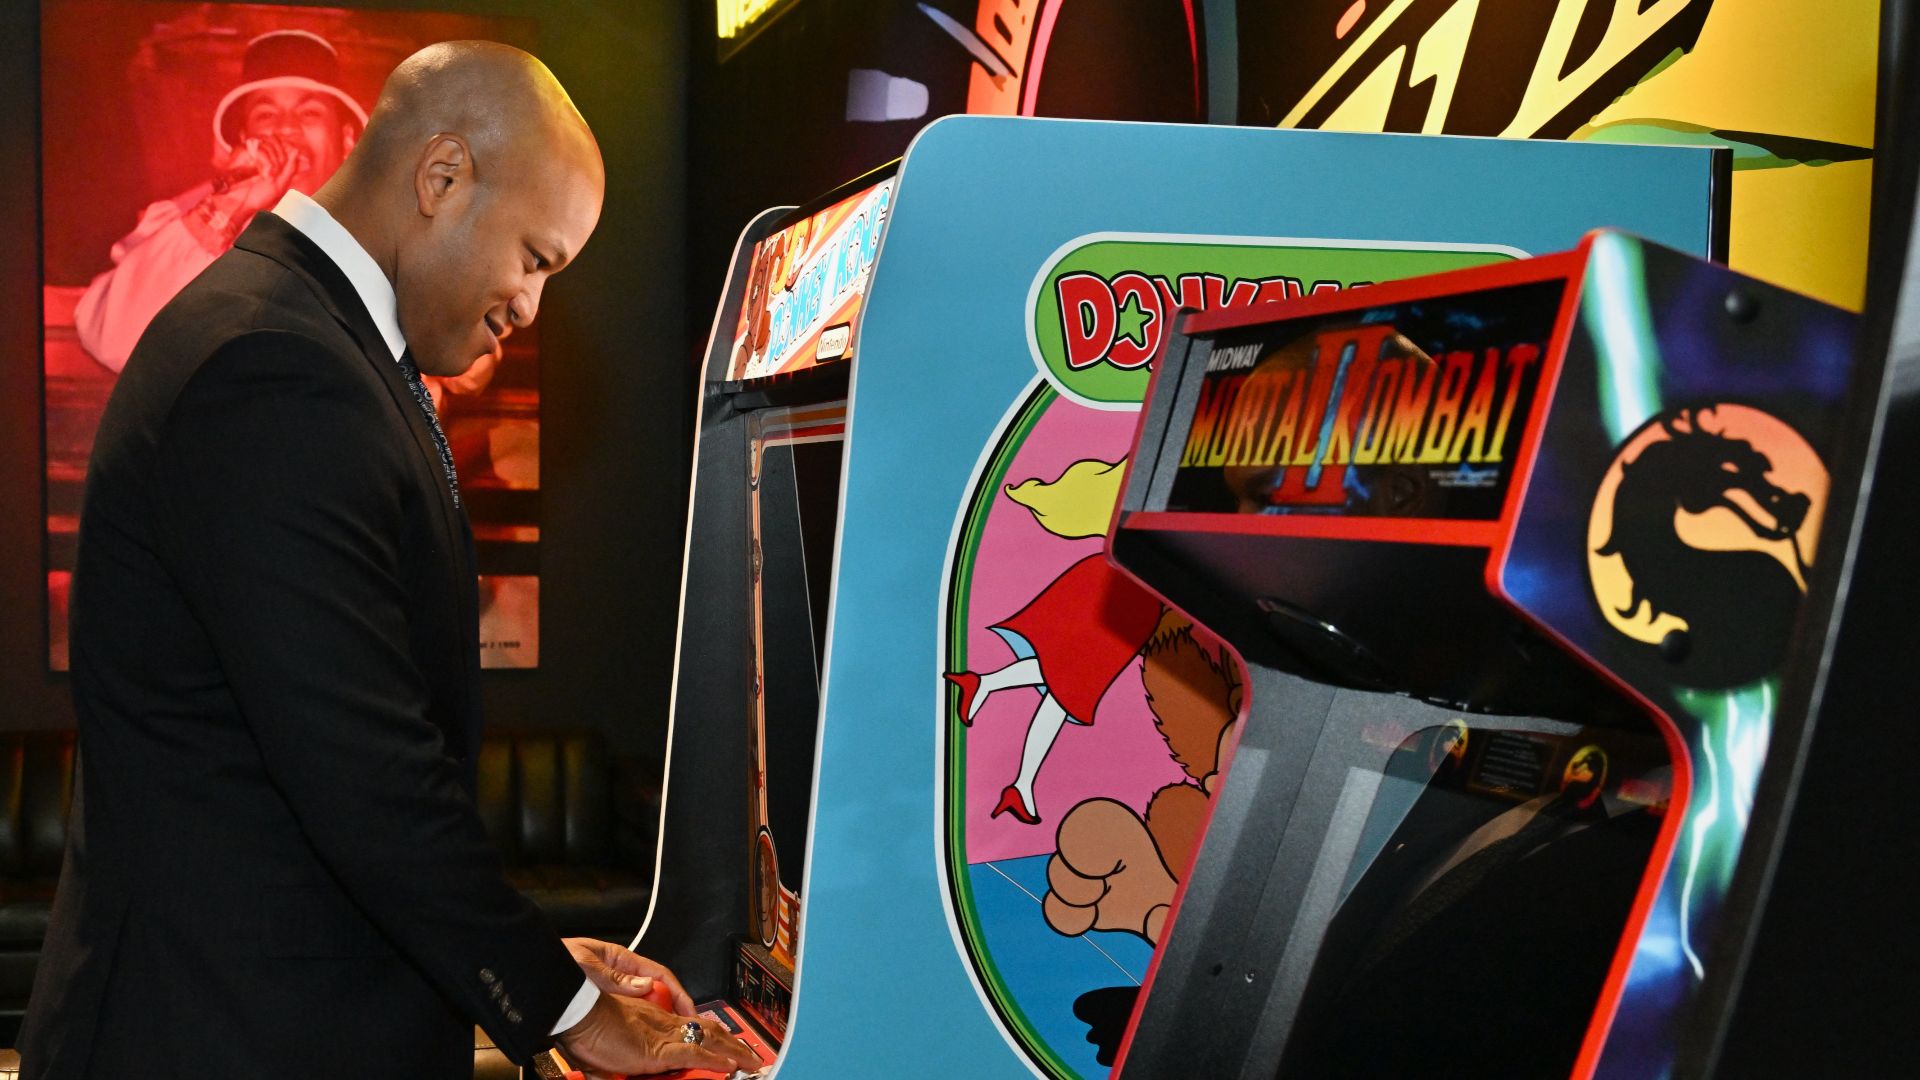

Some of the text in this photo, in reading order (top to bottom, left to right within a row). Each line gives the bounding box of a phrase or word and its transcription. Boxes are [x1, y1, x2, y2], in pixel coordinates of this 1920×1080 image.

[766, 187, 889, 366] DONKEY KONG
[1180, 343, 1539, 467] MORTAL KOMBAT
[1207, 343, 1263, 372] MIDWAY
